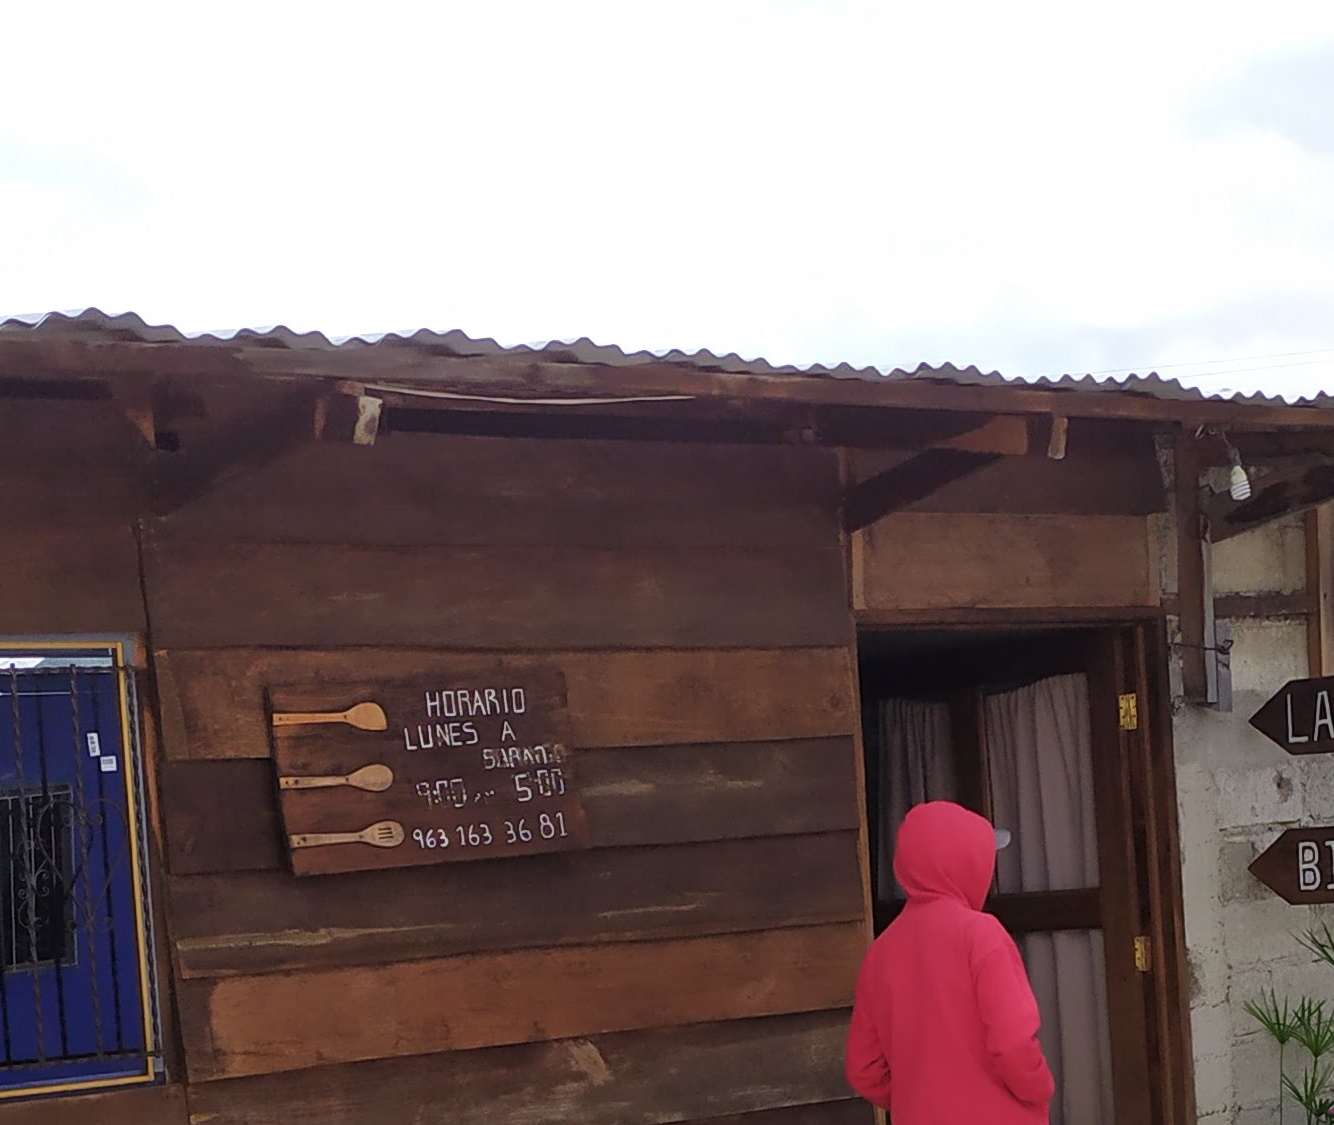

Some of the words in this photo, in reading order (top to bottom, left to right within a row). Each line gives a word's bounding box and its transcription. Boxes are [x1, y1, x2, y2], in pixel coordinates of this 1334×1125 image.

[425, 687, 526, 718] HORARIO
[403, 721, 479, 751] LUNES
[500, 720, 517, 742] A
[412, 828, 450, 849] 963
[455, 823, 493, 846] 163
[504, 818, 533, 844] 36
[539, 811, 568, 839] 81
